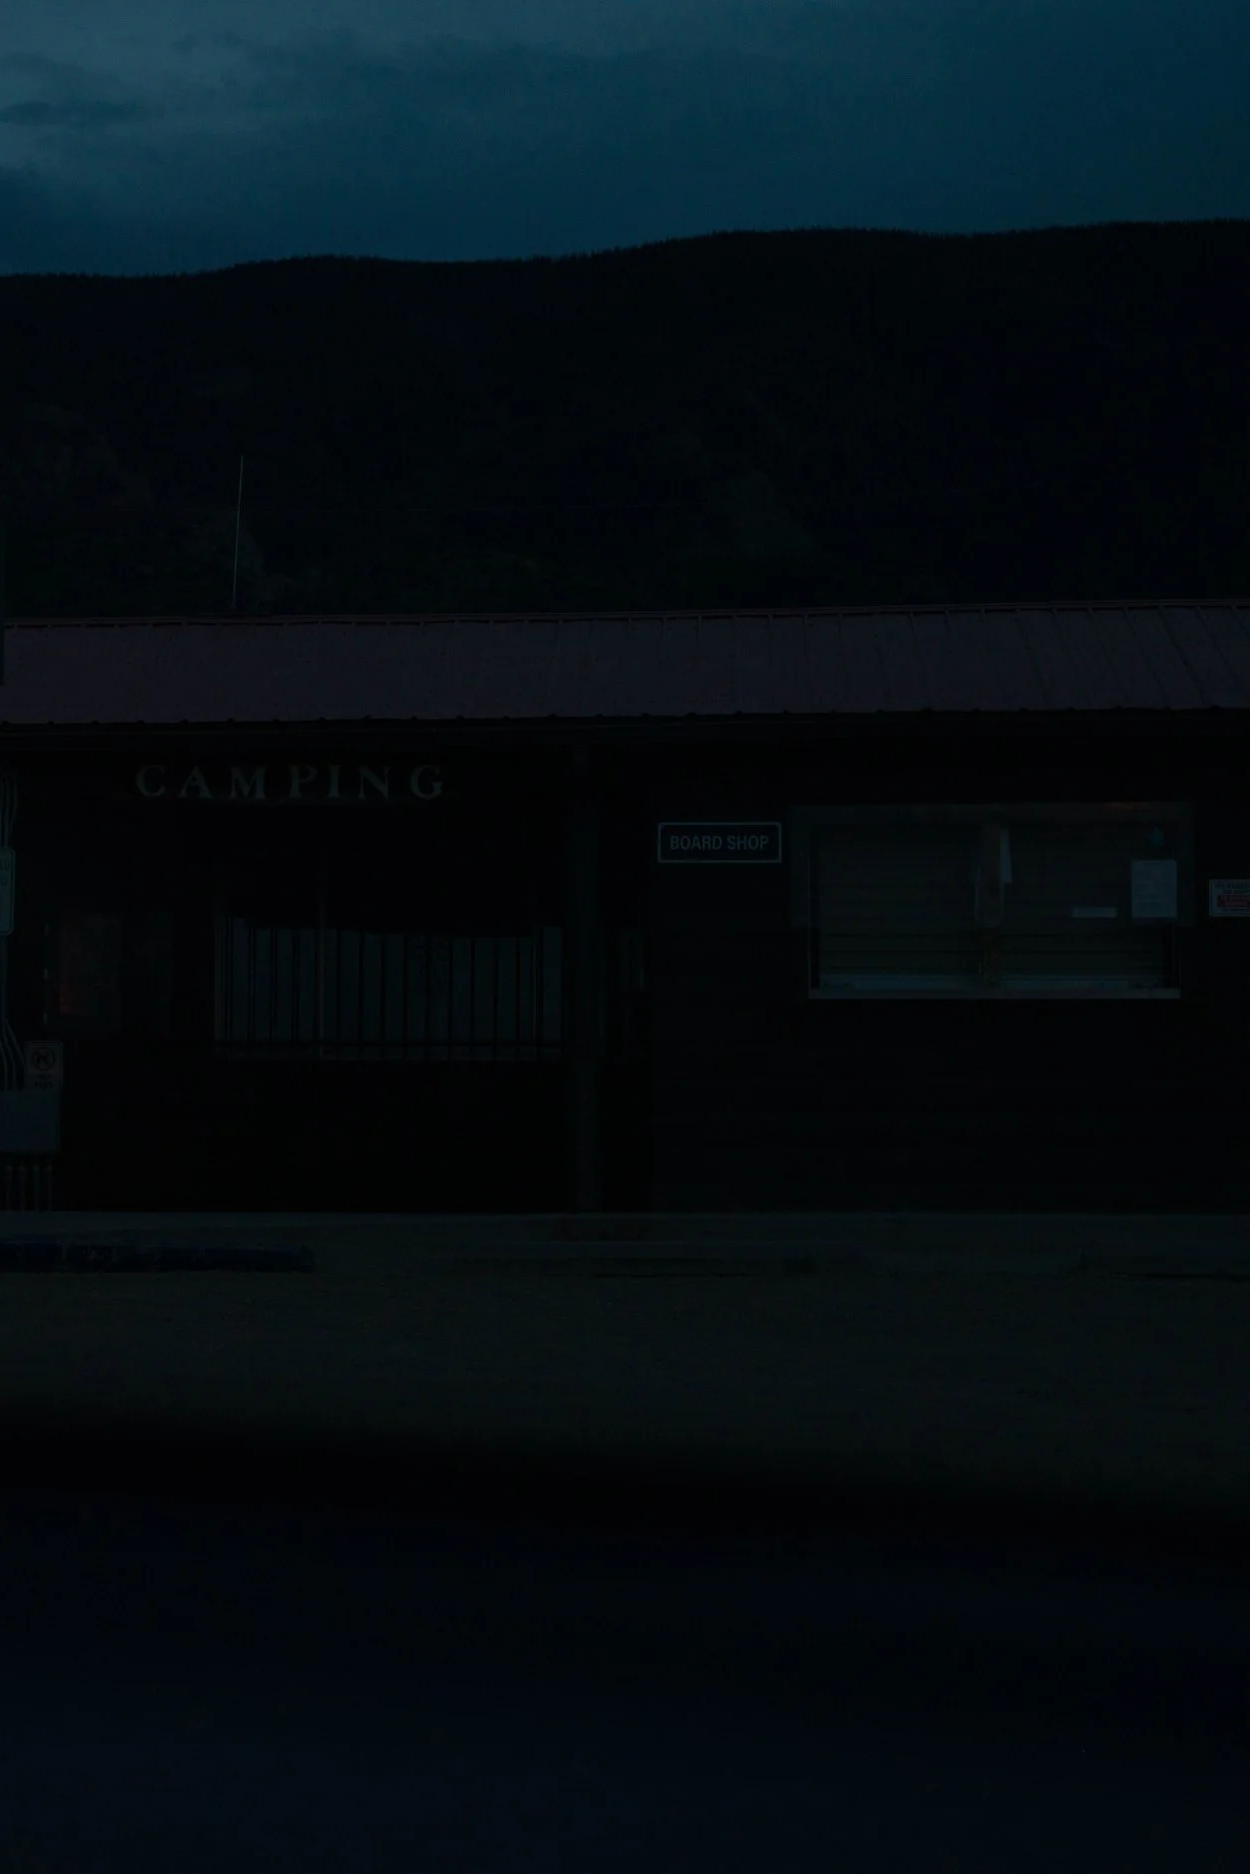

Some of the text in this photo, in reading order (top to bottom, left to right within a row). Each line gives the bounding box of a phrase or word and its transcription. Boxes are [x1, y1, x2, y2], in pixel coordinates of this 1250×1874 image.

[134, 763, 445, 801] CAMPING
[669, 834, 770, 851] BOARD SHOP
